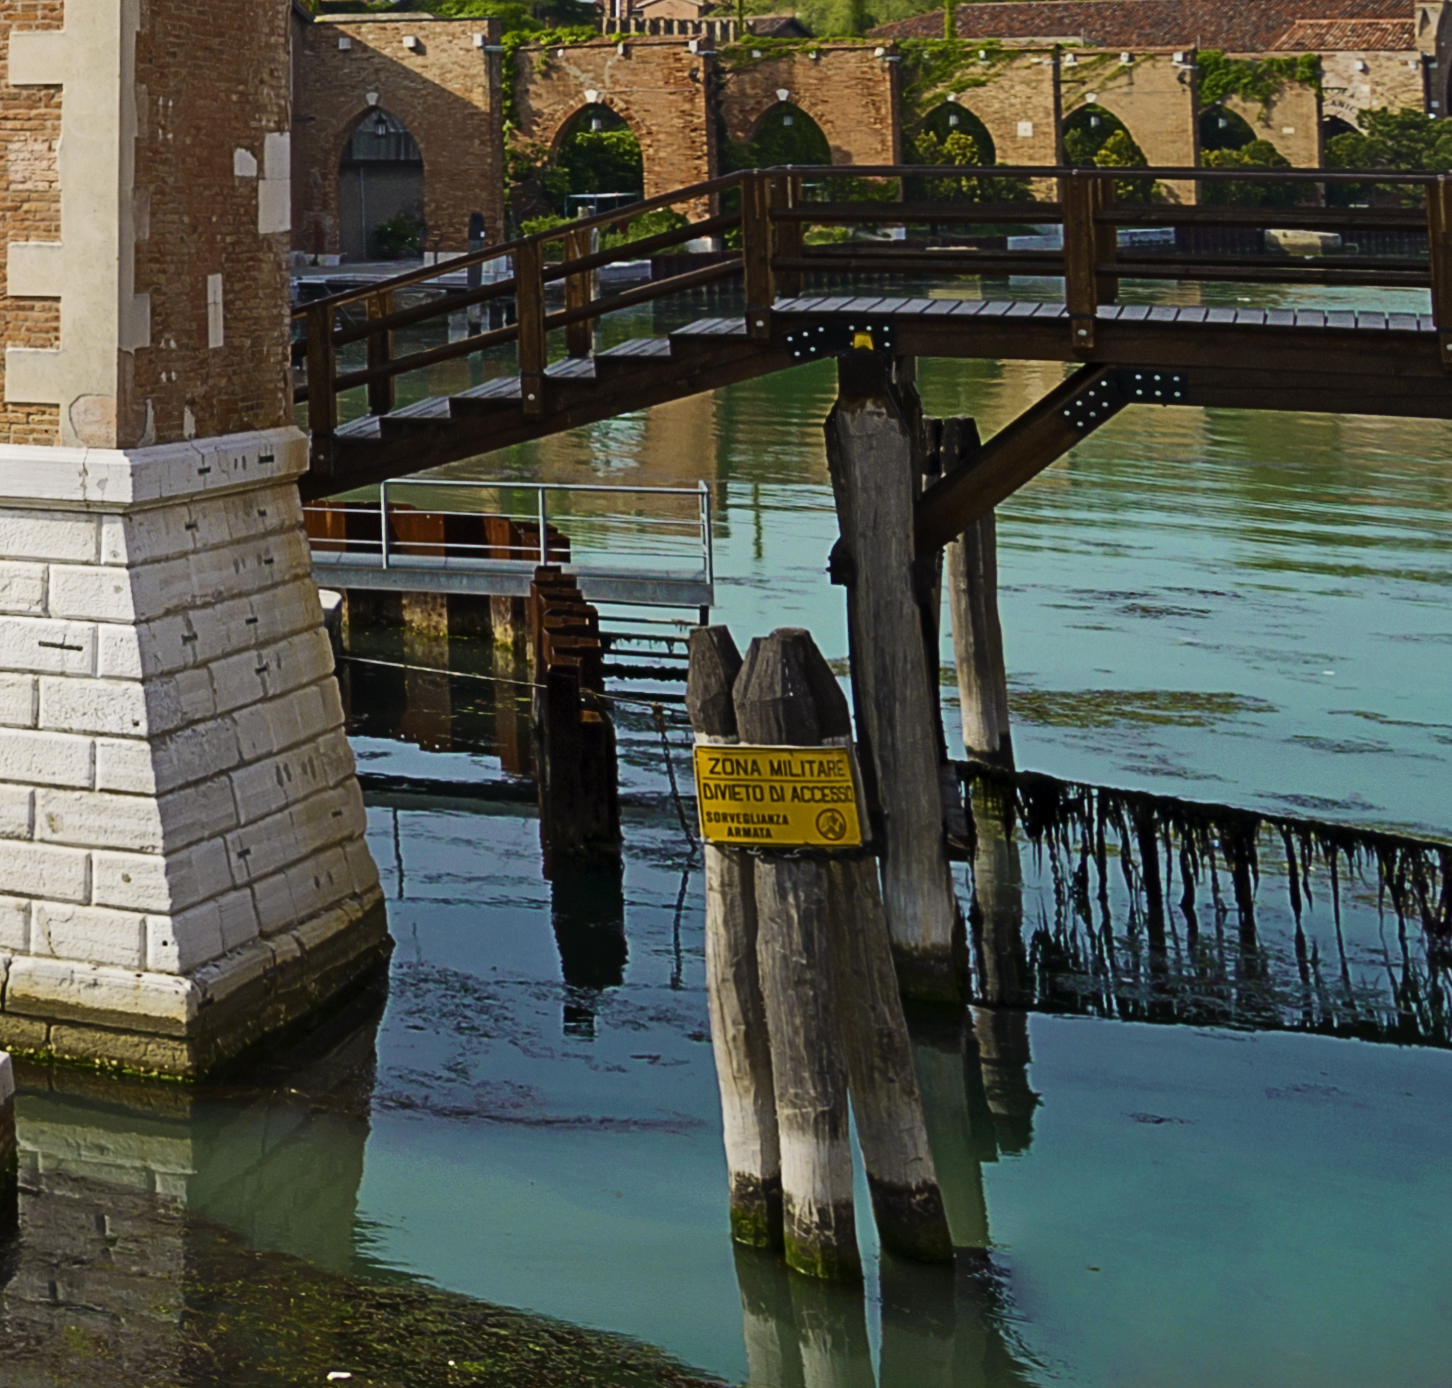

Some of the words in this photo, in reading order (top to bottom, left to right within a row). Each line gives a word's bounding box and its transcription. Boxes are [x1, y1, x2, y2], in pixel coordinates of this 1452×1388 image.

[708, 757, 762, 776] ZONA
[769, 759, 846, 777] MILITARE
[702, 782, 764, 802] DIVIETO
[769, 785, 785, 802] DI
[790, 785, 854, 803] ACCESSO
[705, 811, 789, 825] SORVEGLIANZA
[726, 826, 773, 838] ARMATA
